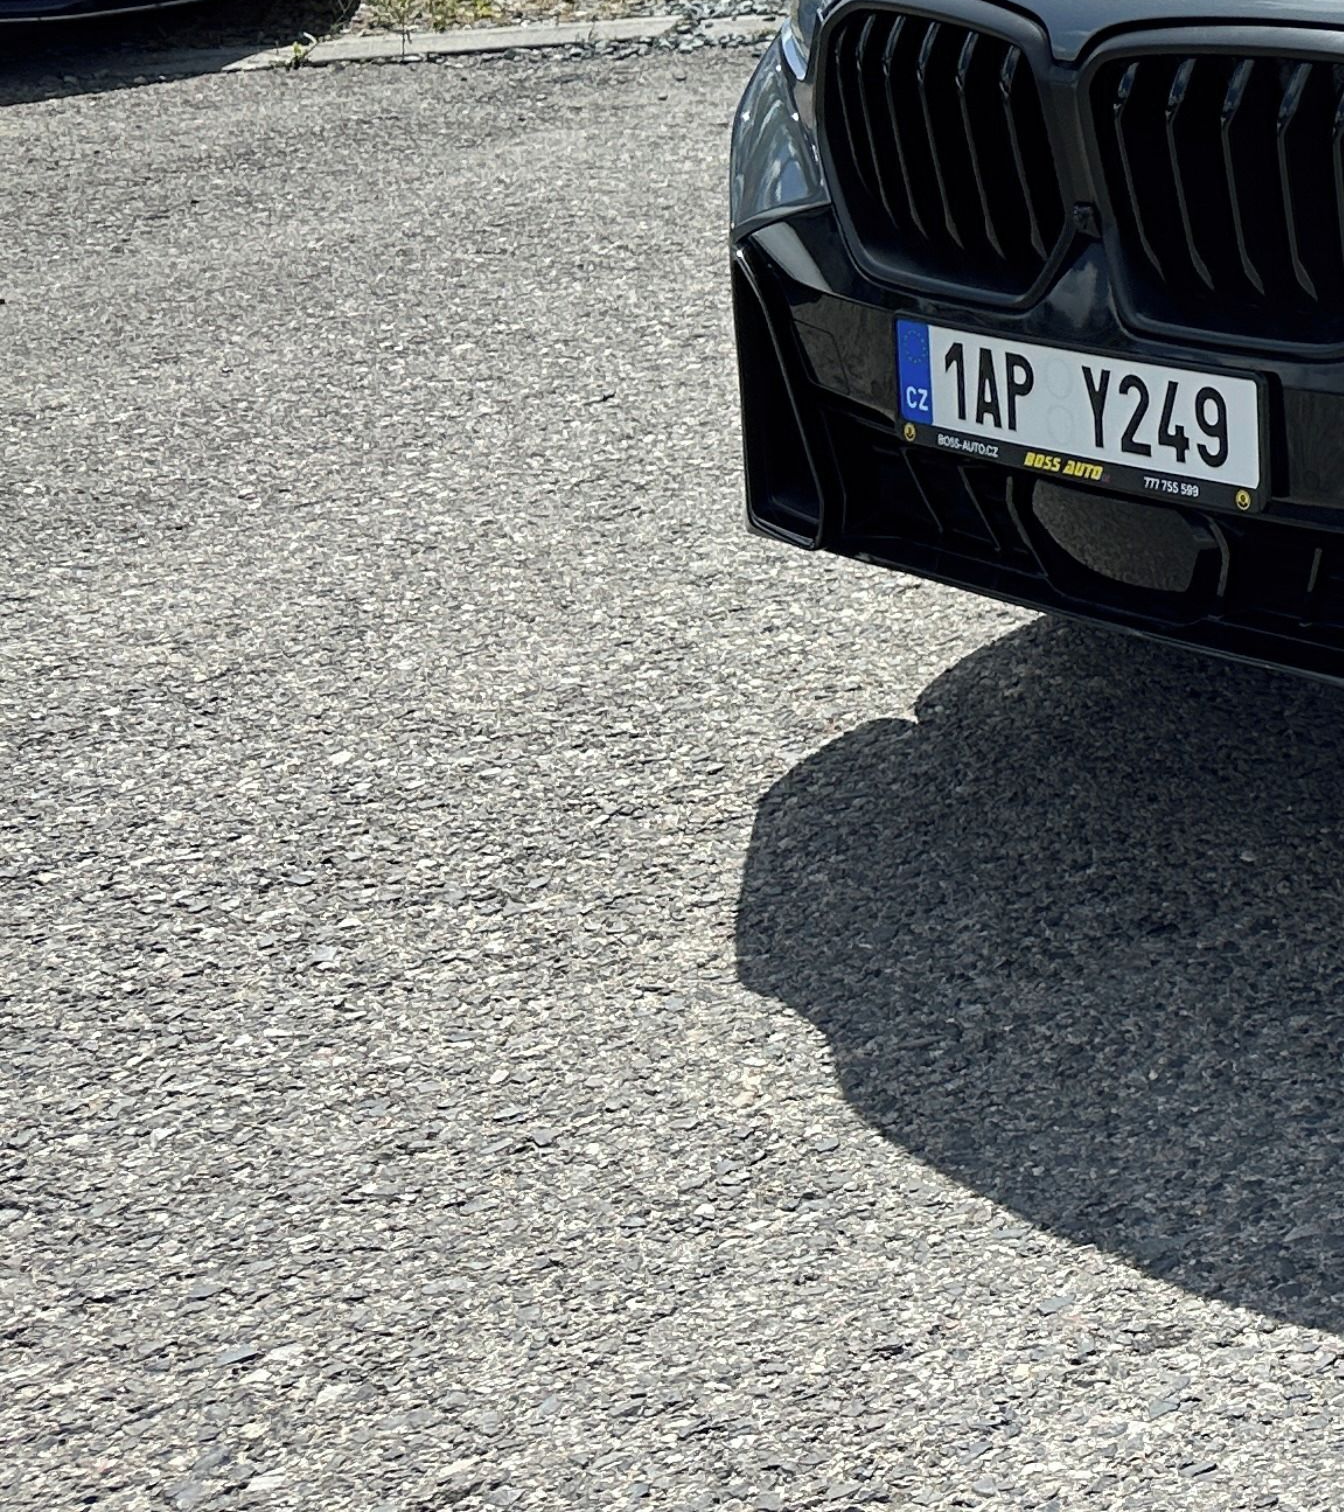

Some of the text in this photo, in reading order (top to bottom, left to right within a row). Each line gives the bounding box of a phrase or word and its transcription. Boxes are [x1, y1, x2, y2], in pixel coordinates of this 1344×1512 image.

[906, 386, 929, 412] CZ
[945, 343, 1228, 468] 1AP Y249
[1023, 451, 1104, 481] BOSS AUTO
[1143, 476, 1160, 491] 777
[1161, 479, 1179, 494] 755
